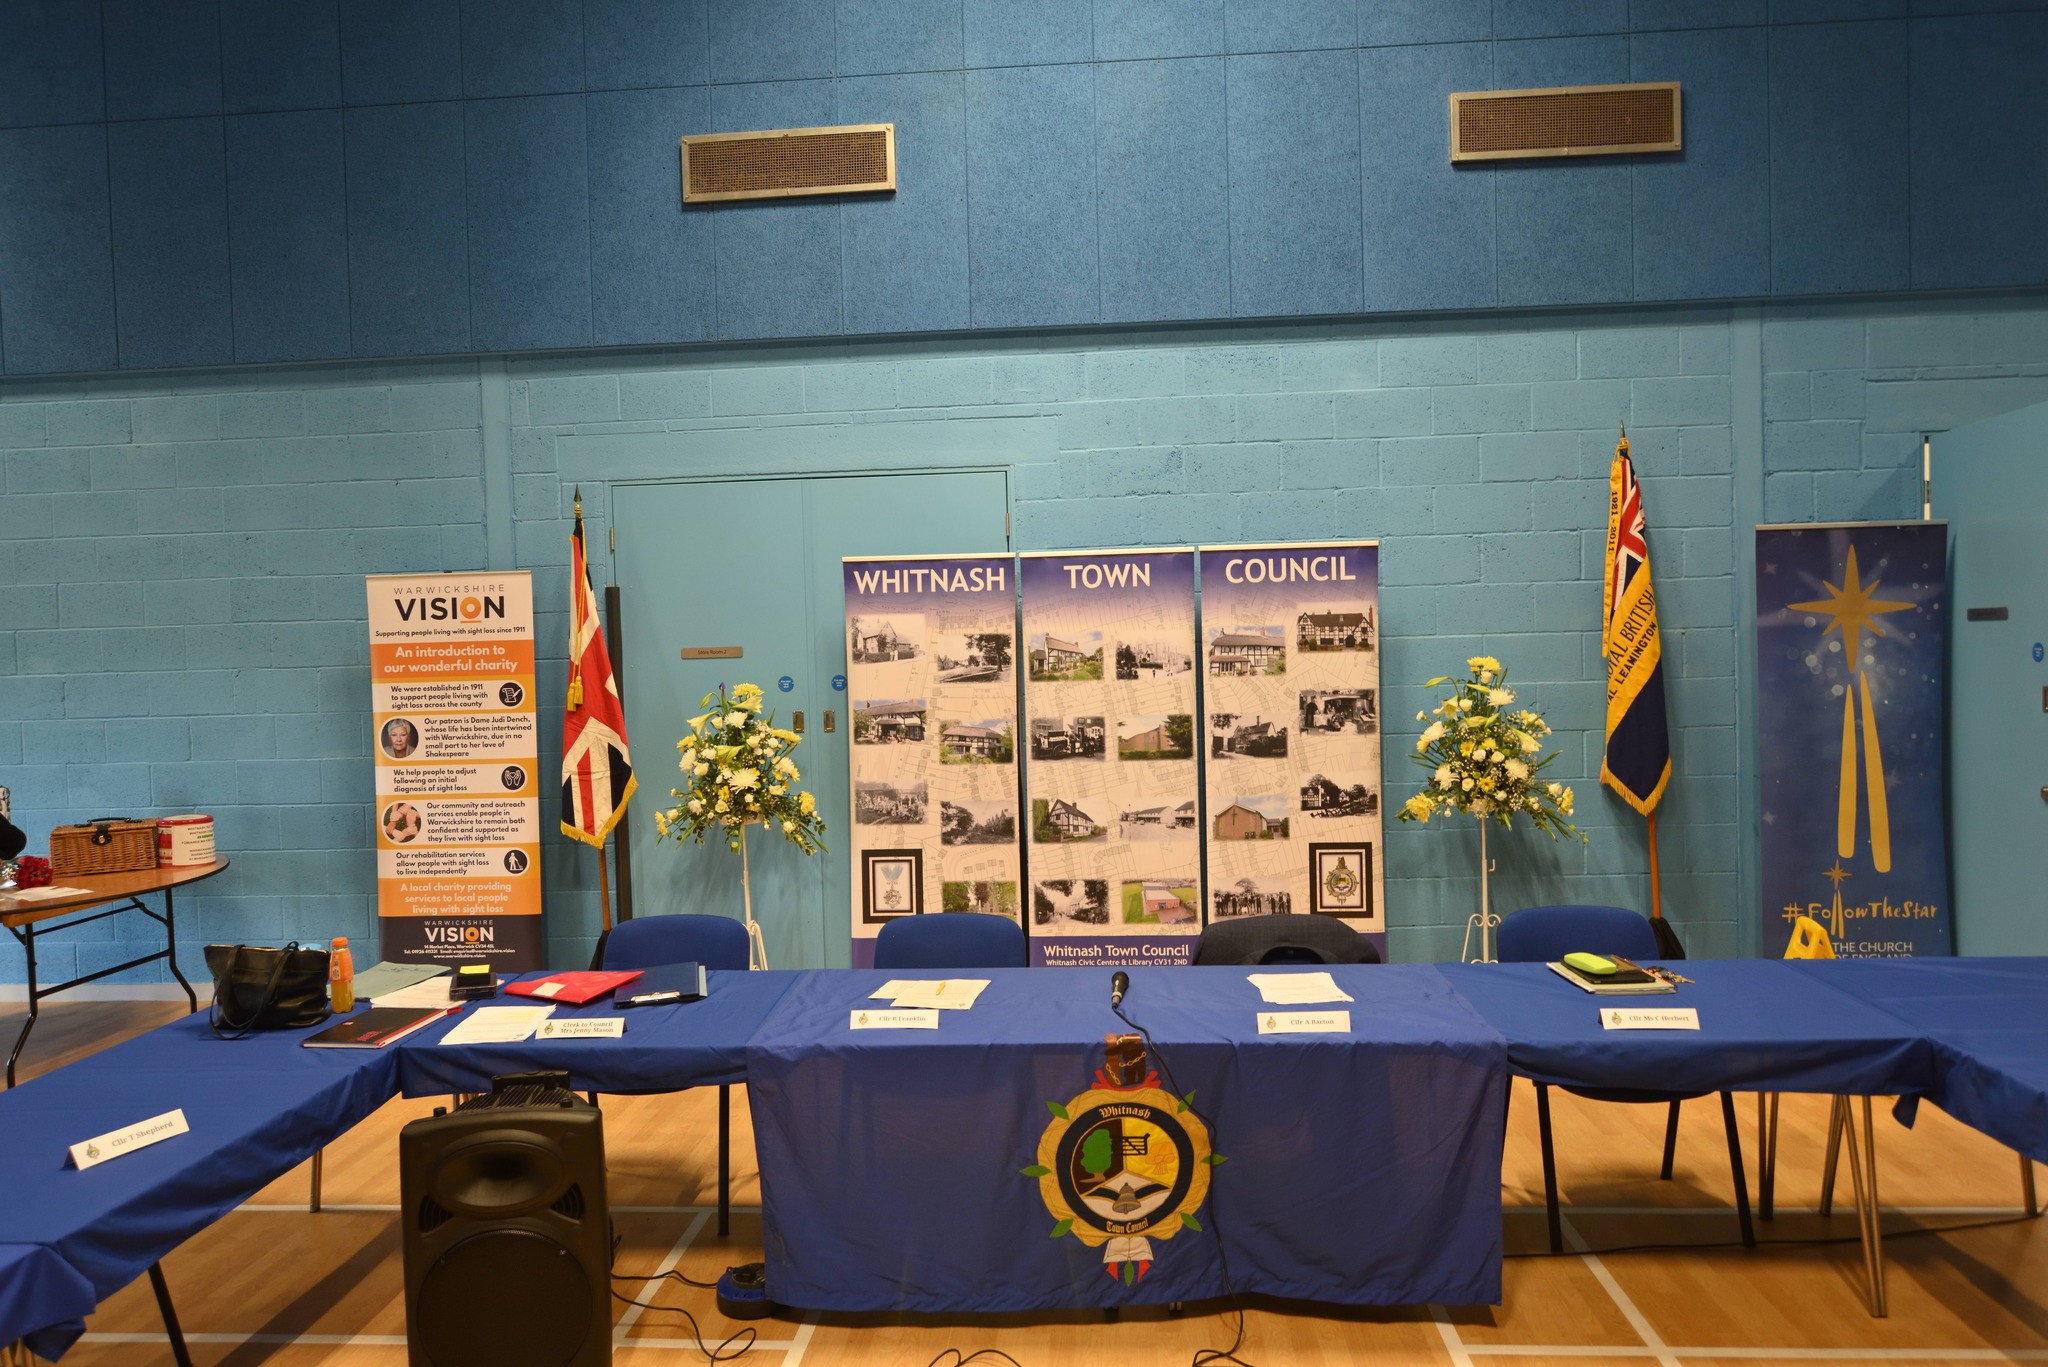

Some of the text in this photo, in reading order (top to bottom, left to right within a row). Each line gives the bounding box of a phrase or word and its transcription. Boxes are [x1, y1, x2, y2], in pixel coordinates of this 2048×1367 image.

[1608, 527, 1616, 551] 2011
[1063, 563, 1150, 589] TOWN
[1225, 556, 1356, 584] COUNCIL
[853, 568, 1005, 594] WHITNASH
[394, 584, 504, 595] WARWICKSHIRE
[394, 596, 505, 621] VISION
[1619, 590, 1655, 642] BRITISH
[411, 629, 432, 637] people
[468, 628, 482, 636] sight
[395, 644, 505, 658] An introduction to
[1615, 621, 1657, 684] LEAMINGTON
[384, 658, 518, 673] our wonderful charity
[428, 692, 451, 701] people
[392, 702, 408, 710] sight
[406, 768, 421, 777] help
[422, 768, 446, 777] people
[455, 768, 476, 776] adjust
[394, 777, 426, 785] following
[394, 784, 427, 794] diagnosis
[436, 784, 453, 793] sight
[480, 809, 502, 818] people
[417, 860, 440, 868] people
[458, 859, 475, 867] sight
[419, 868, 467, 876] independently
[400, 881, 512, 893] A local charity providing
[405, 894, 441, 903] services
[454, 893, 476, 902] local
[478, 892, 508, 903] people
[412, 904, 504, 916] living with sight loss
[425, 927, 494, 942] VISION
[1043, 944, 1189, 957] Whitnash Town Council
[1832, 942, 1912, 952] THE CHURCH
[1099, 1105, 1150, 1119] Whitnash
[111, 1138, 127, 1147] Cllr
[136, 1121, 174, 1138] Shepherd
[1106, 1217, 1149, 1233] Town Council
